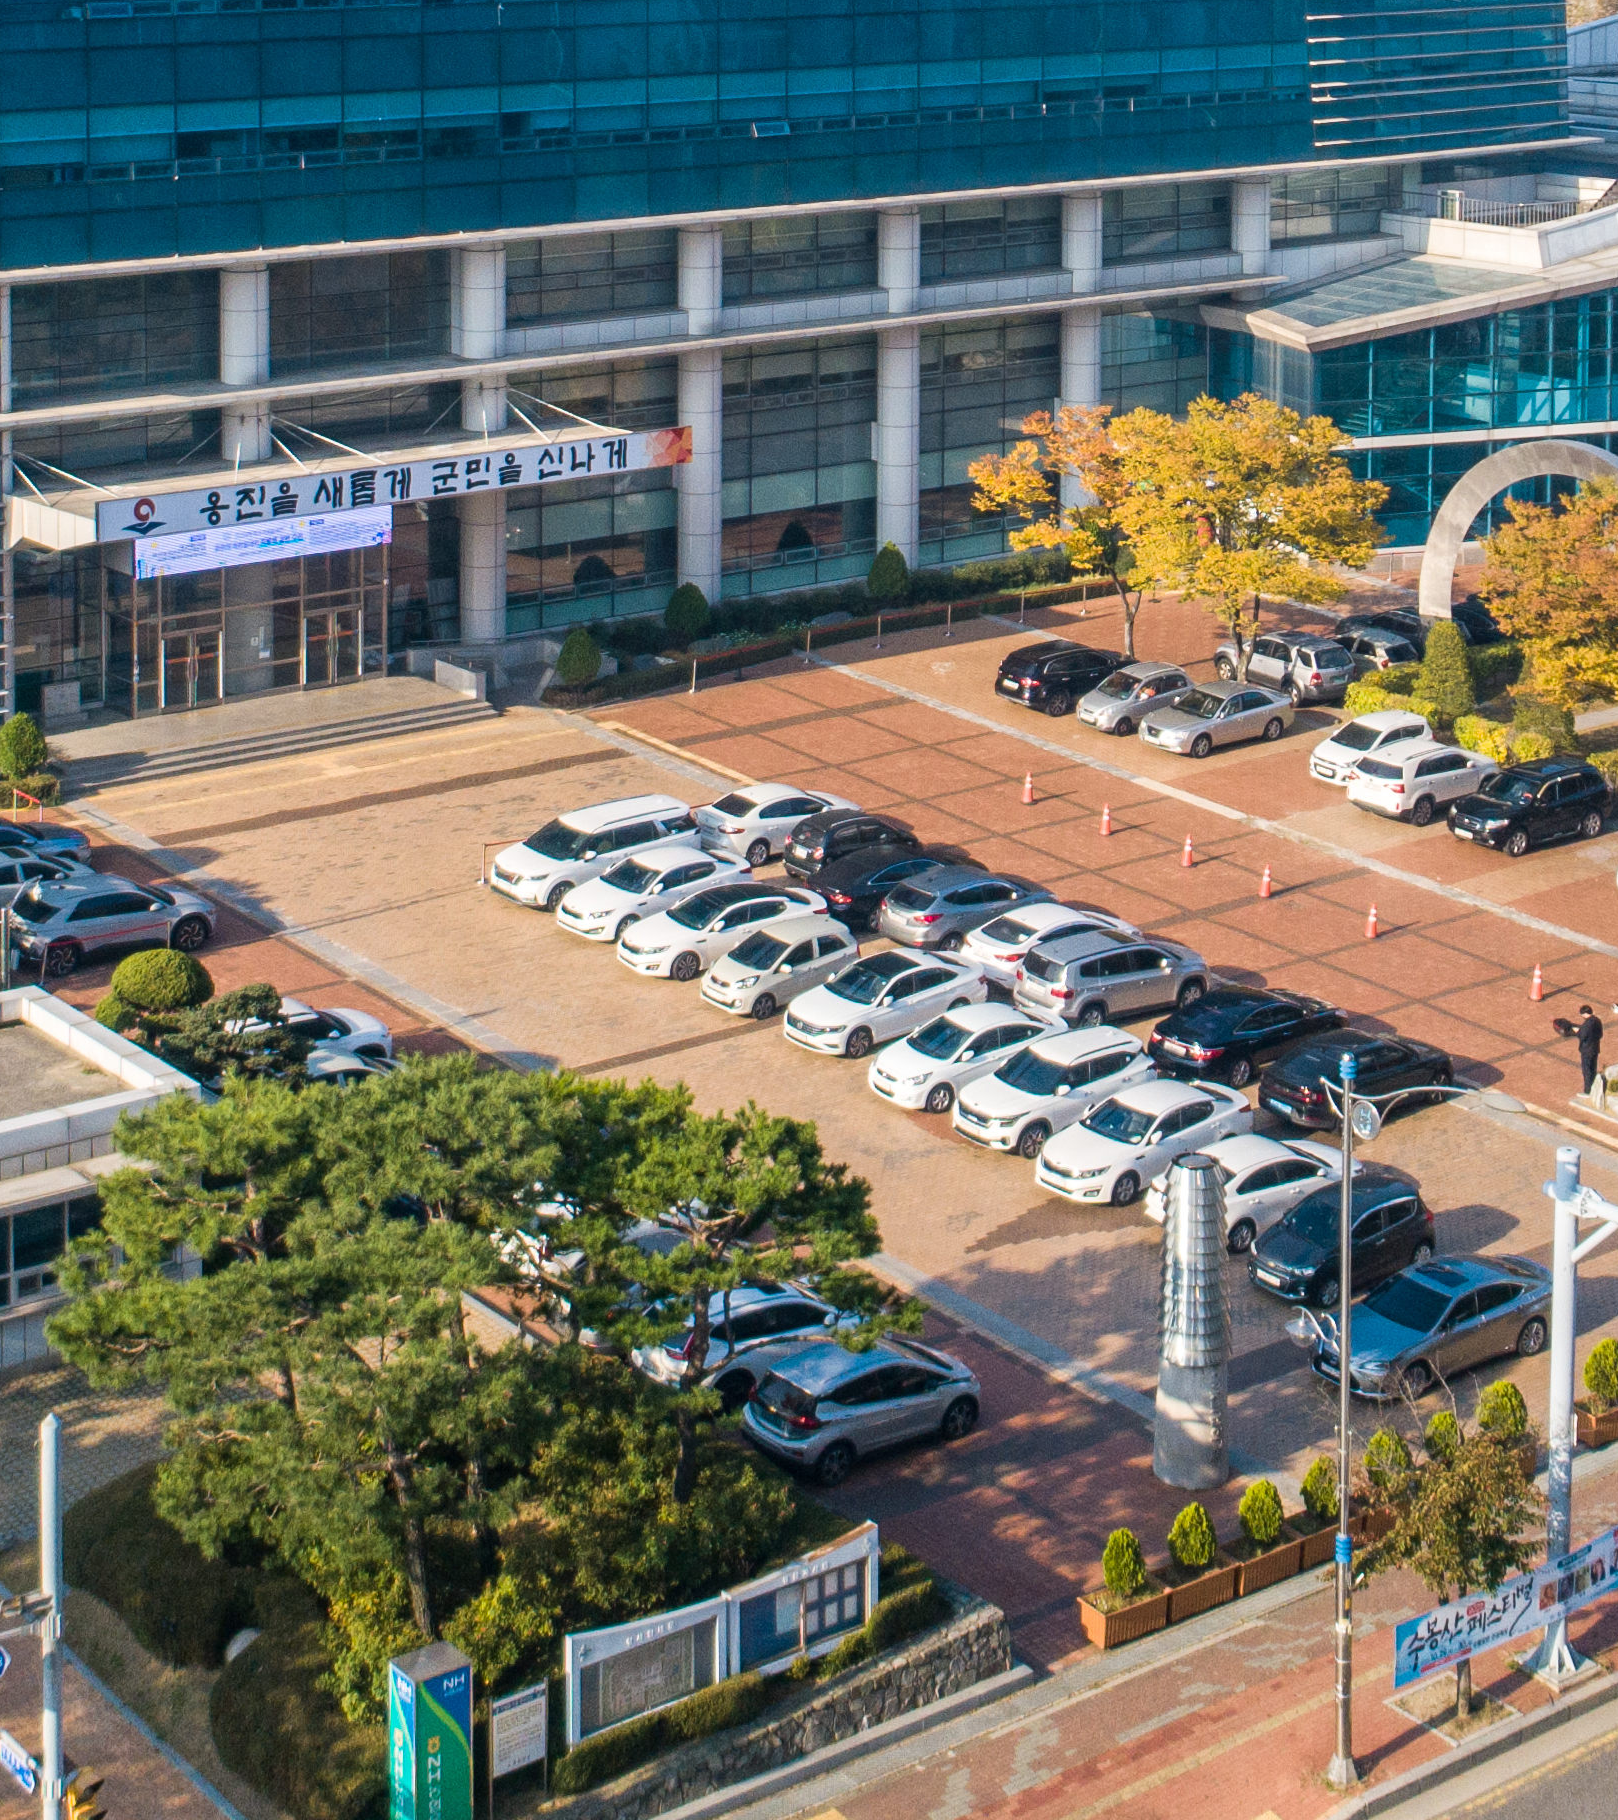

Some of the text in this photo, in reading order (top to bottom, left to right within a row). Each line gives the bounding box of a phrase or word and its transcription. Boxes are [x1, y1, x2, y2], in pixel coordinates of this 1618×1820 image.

[199, 437, 629, 526] 옹진을 새롭게 군민을 신나게
[1408, 1576, 1534, 1672] 수봉산 페스티벌
[443, 1673, 465, 1691] NH
